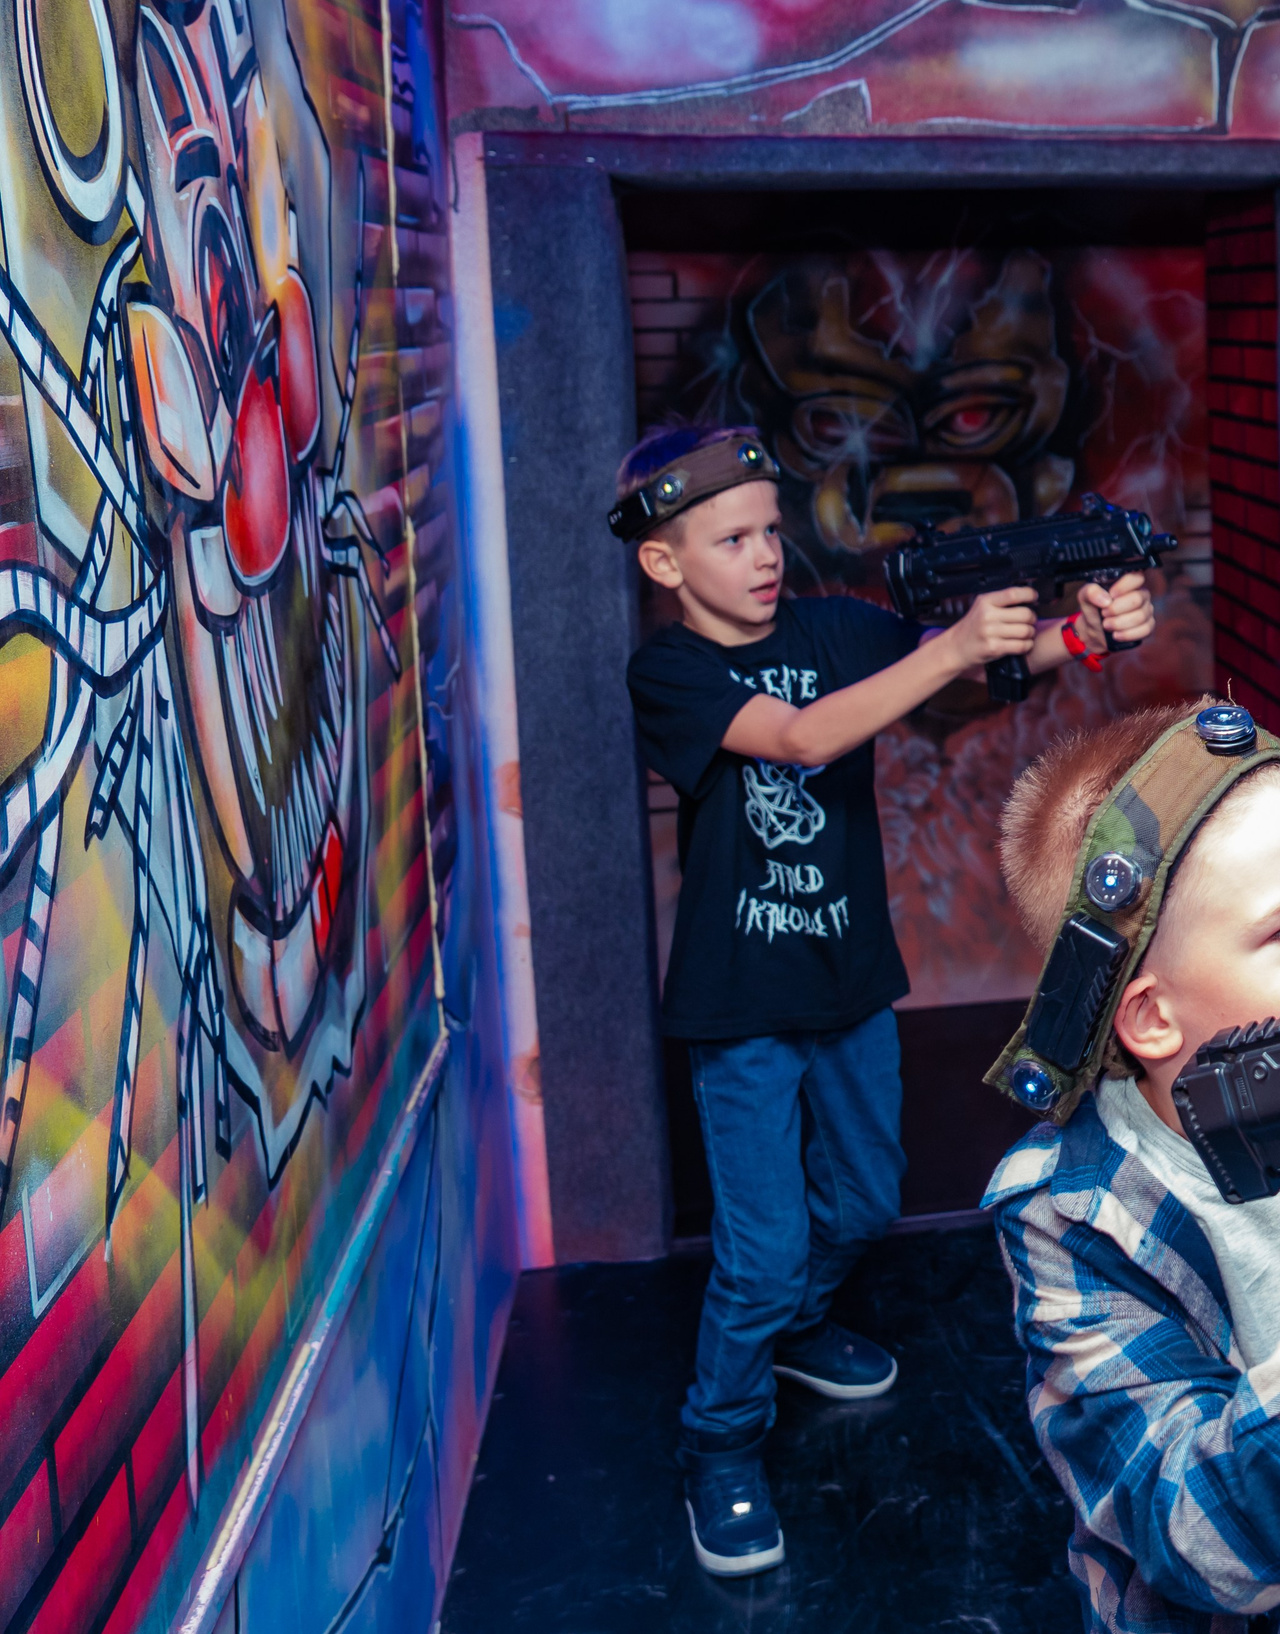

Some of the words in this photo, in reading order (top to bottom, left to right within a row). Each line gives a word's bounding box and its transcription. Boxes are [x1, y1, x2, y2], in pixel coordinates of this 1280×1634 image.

[758, 859, 825, 898] AND
[735, 888, 747, 928] I
[745, 897, 829, 943] KNOW
[828, 895, 850, 938] IT
